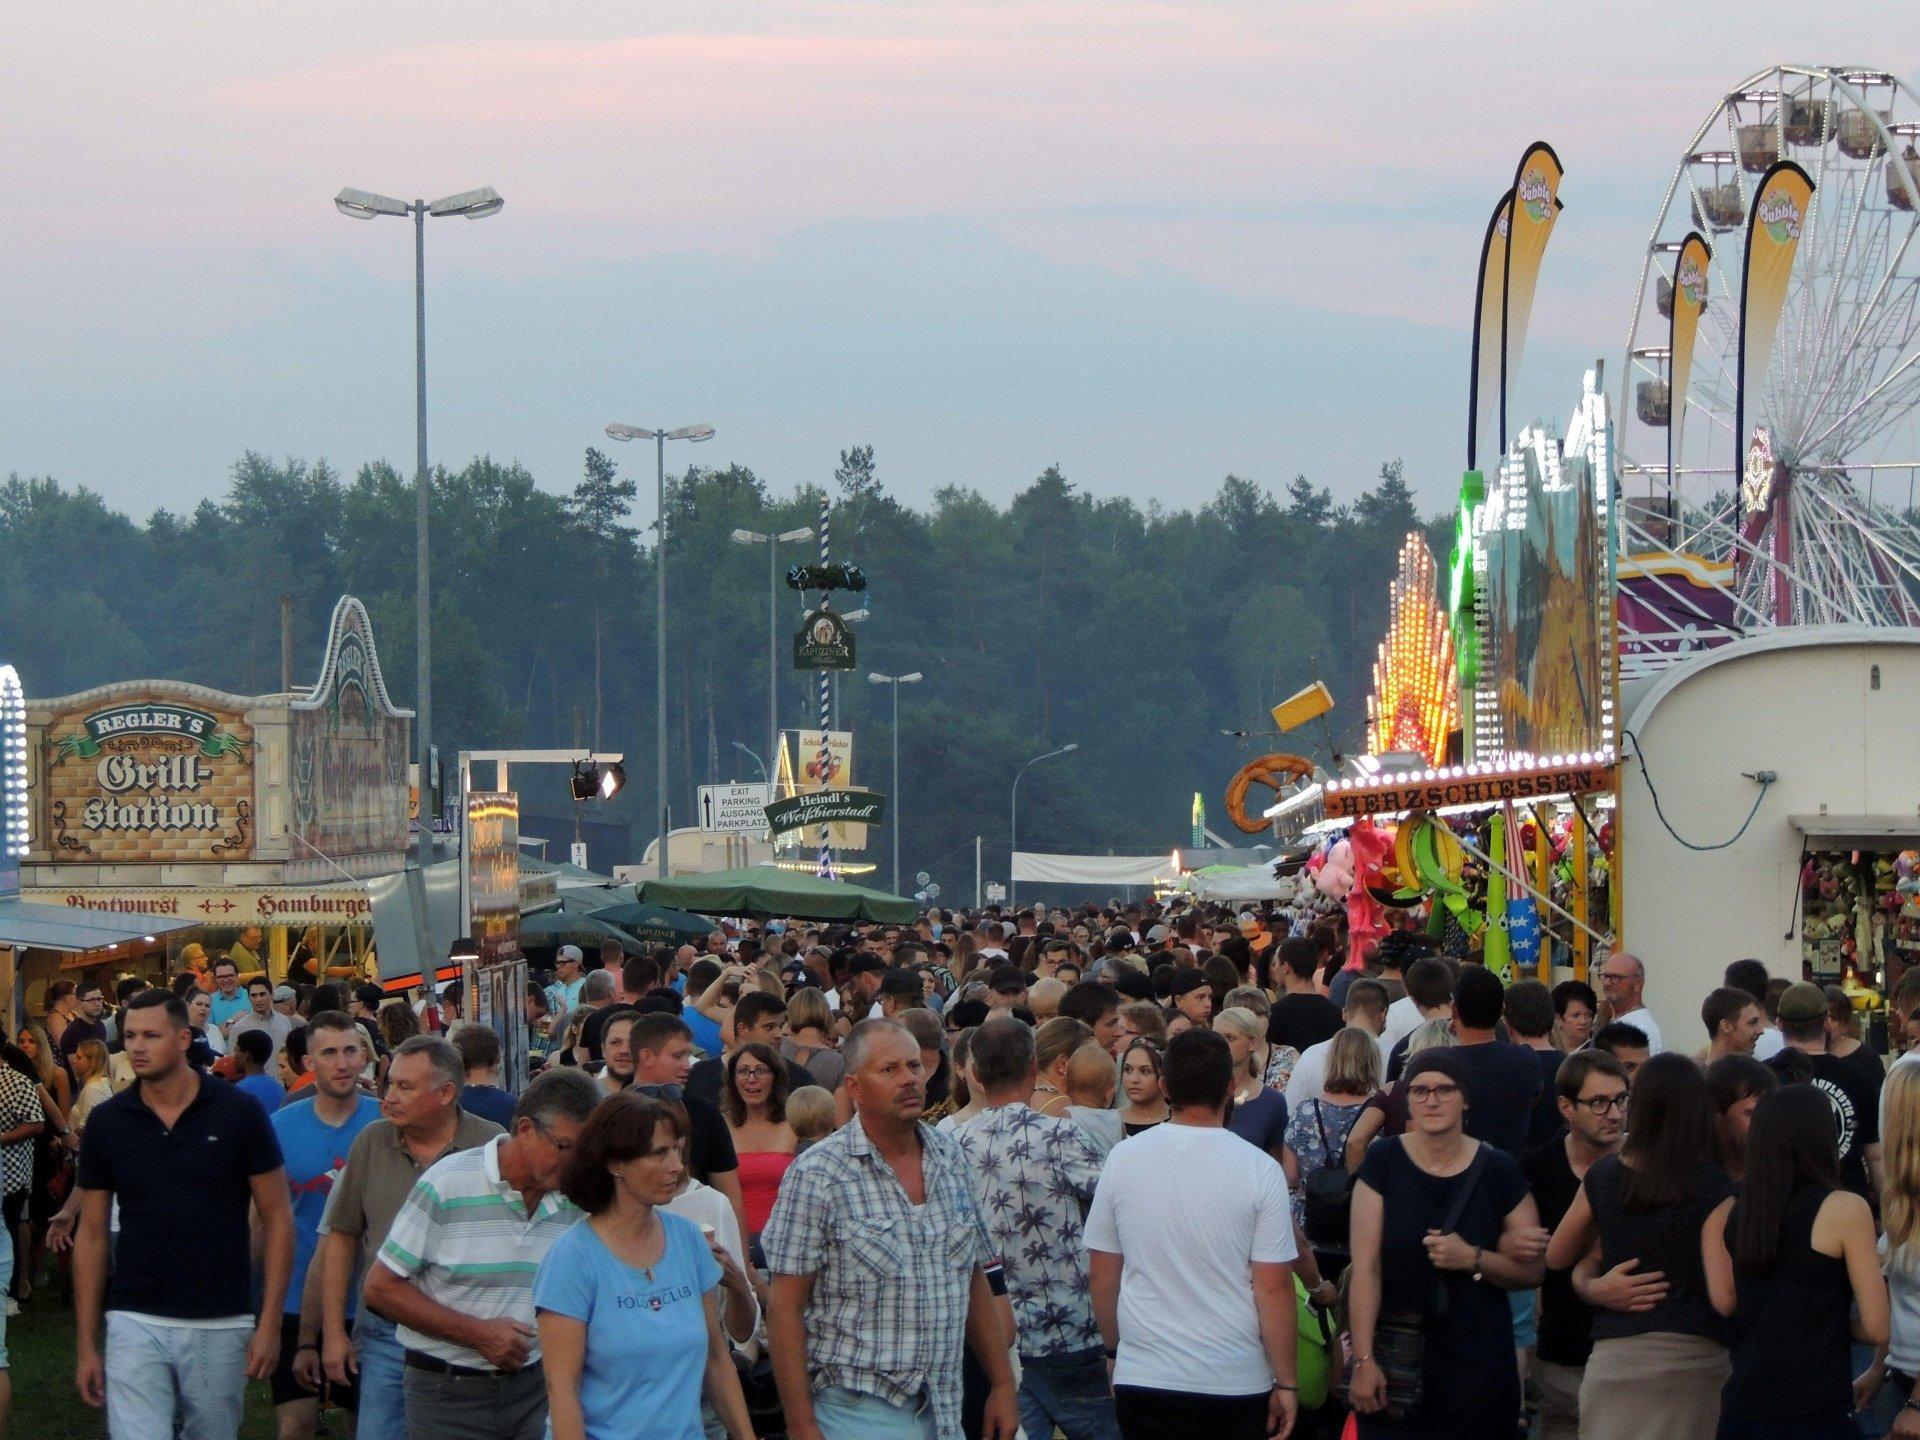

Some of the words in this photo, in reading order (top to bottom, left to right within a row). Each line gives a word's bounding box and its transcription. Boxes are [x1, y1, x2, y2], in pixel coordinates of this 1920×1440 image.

[1759, 201, 1799, 224] Bubble
[731, 787, 750, 796] EXIT
[1340, 769, 1593, 815] HERZSCHIESSEN
[721, 797, 760, 806] PARKING
[720, 808, 763, 818] AUSGANG
[717, 818, 767, 828] PARKPLATZ
